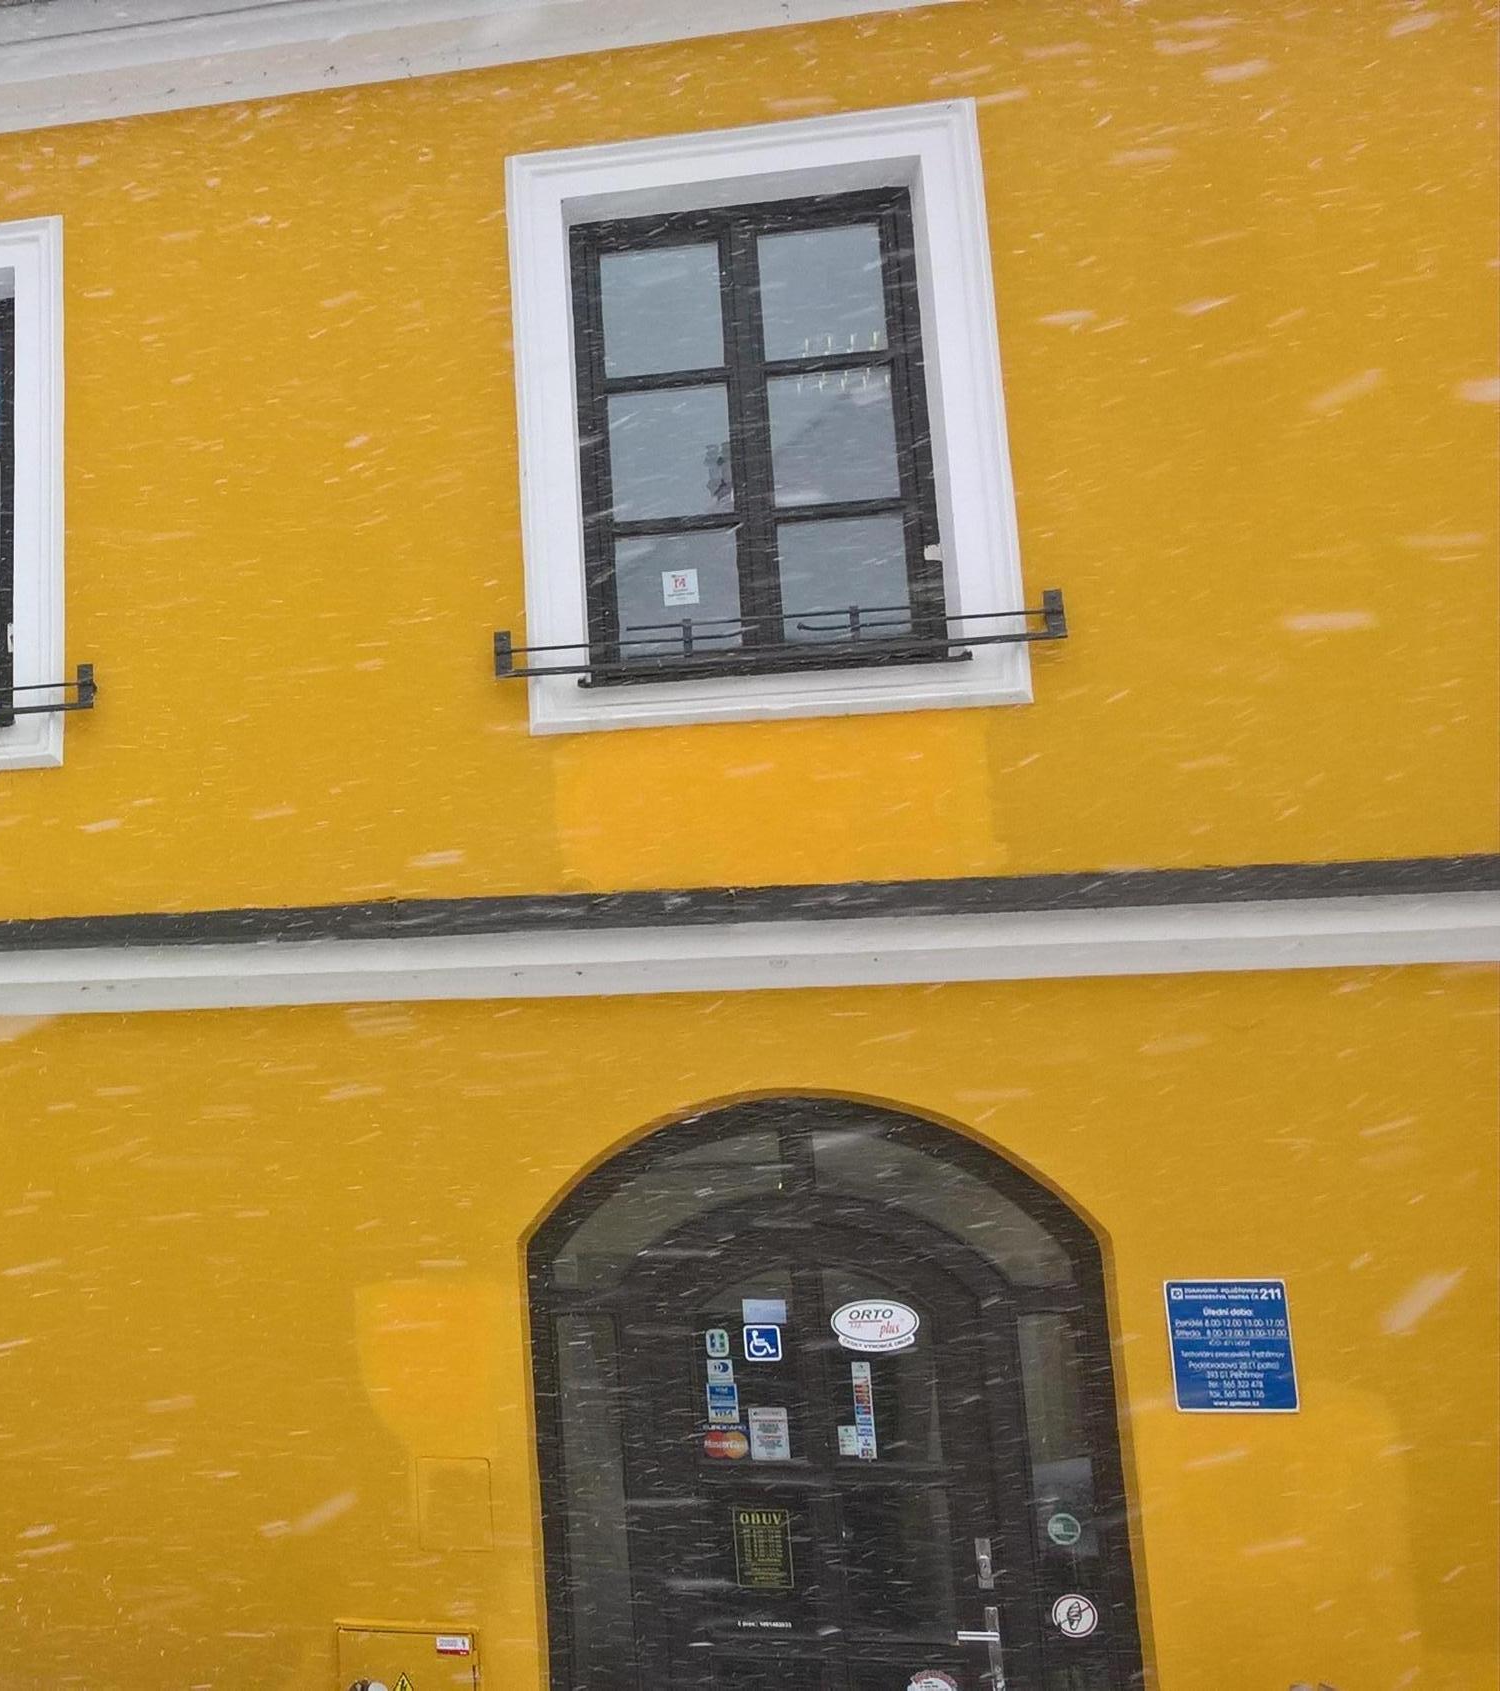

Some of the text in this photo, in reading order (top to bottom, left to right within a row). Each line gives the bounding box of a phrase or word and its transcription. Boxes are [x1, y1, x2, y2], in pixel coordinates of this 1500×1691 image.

[1260, 1288, 1282, 1300] 211
[848, 1308, 894, 1321] ORTO
[879, 1321, 901, 1339] plus
[739, 1511, 782, 1525] OBUV
